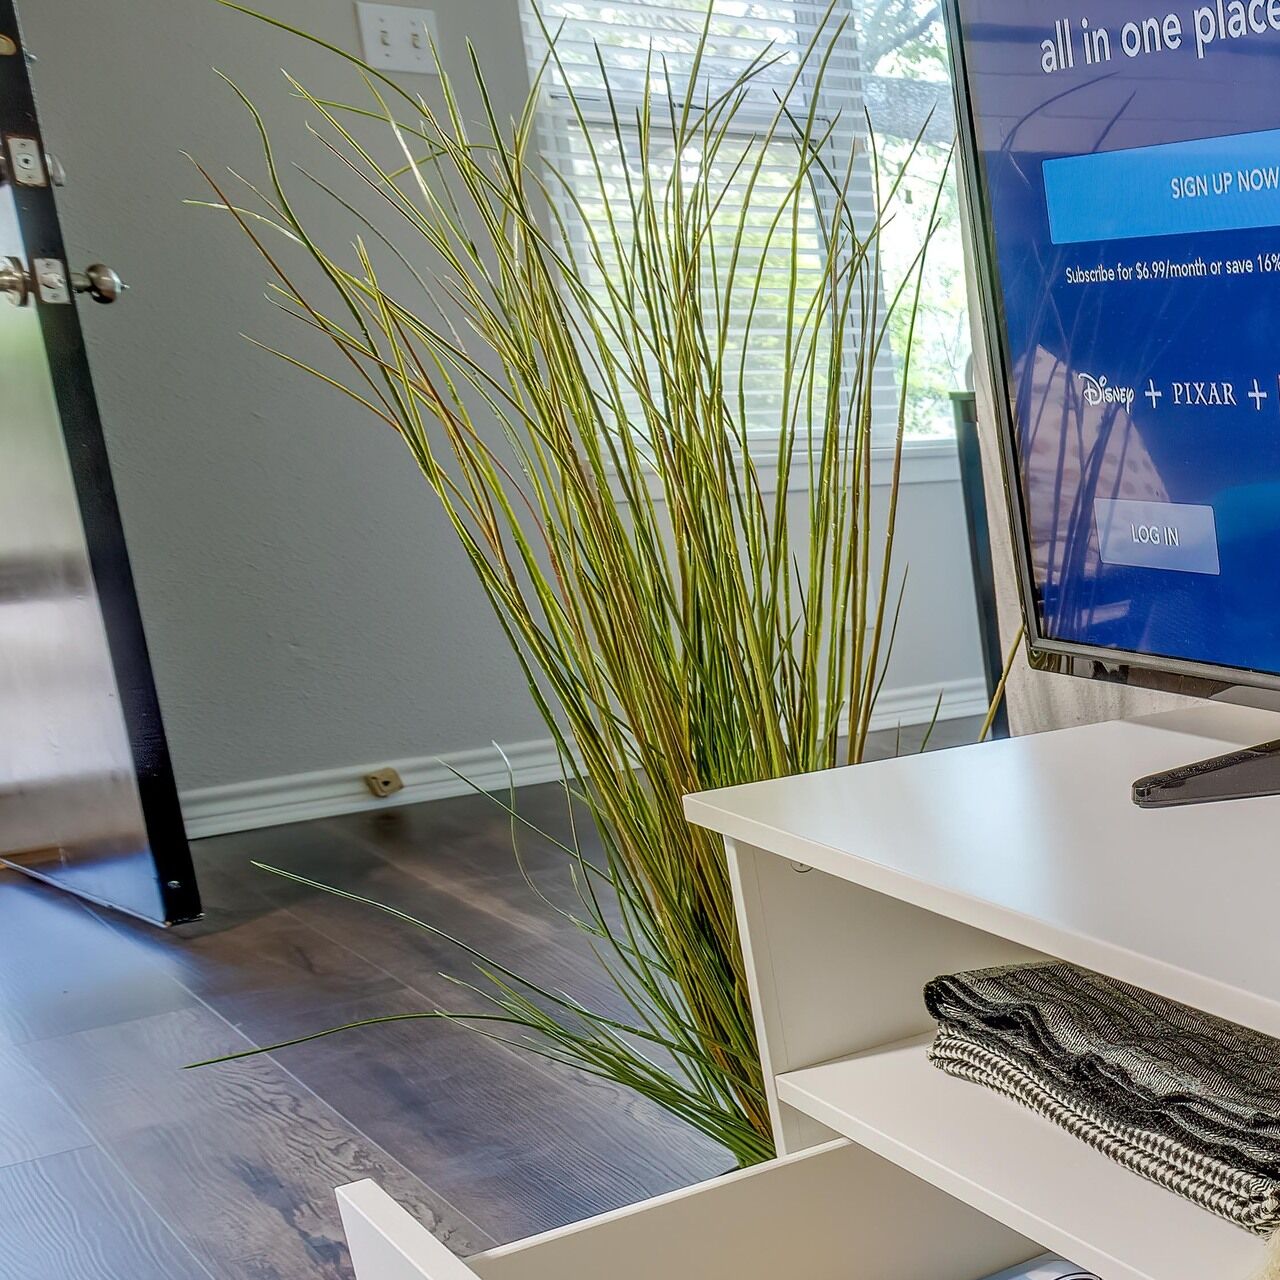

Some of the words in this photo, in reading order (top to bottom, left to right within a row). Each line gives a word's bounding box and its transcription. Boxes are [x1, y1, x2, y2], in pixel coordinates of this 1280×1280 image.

[1041, 18, 1074, 73] all
[1081, 17, 1111, 64] in
[1121, 13, 1182, 57] one
[1171, 175, 1209, 199] SIGN
[1212, 173, 1233, 195] UP
[1238, 166, 1280, 191] NOW
[1065, 263, 1115, 284] Subscribe
[1117, 262, 1133, 281] for
[1135, 257, 1207, 281] $6.99/month
[1210, 260, 1223, 275] or
[1226, 259, 1253, 274] save
[1172, 382, 1237, 406] PIXAR
[1131, 524, 1160, 545] LOG
[1164, 526, 1179, 546] IN
